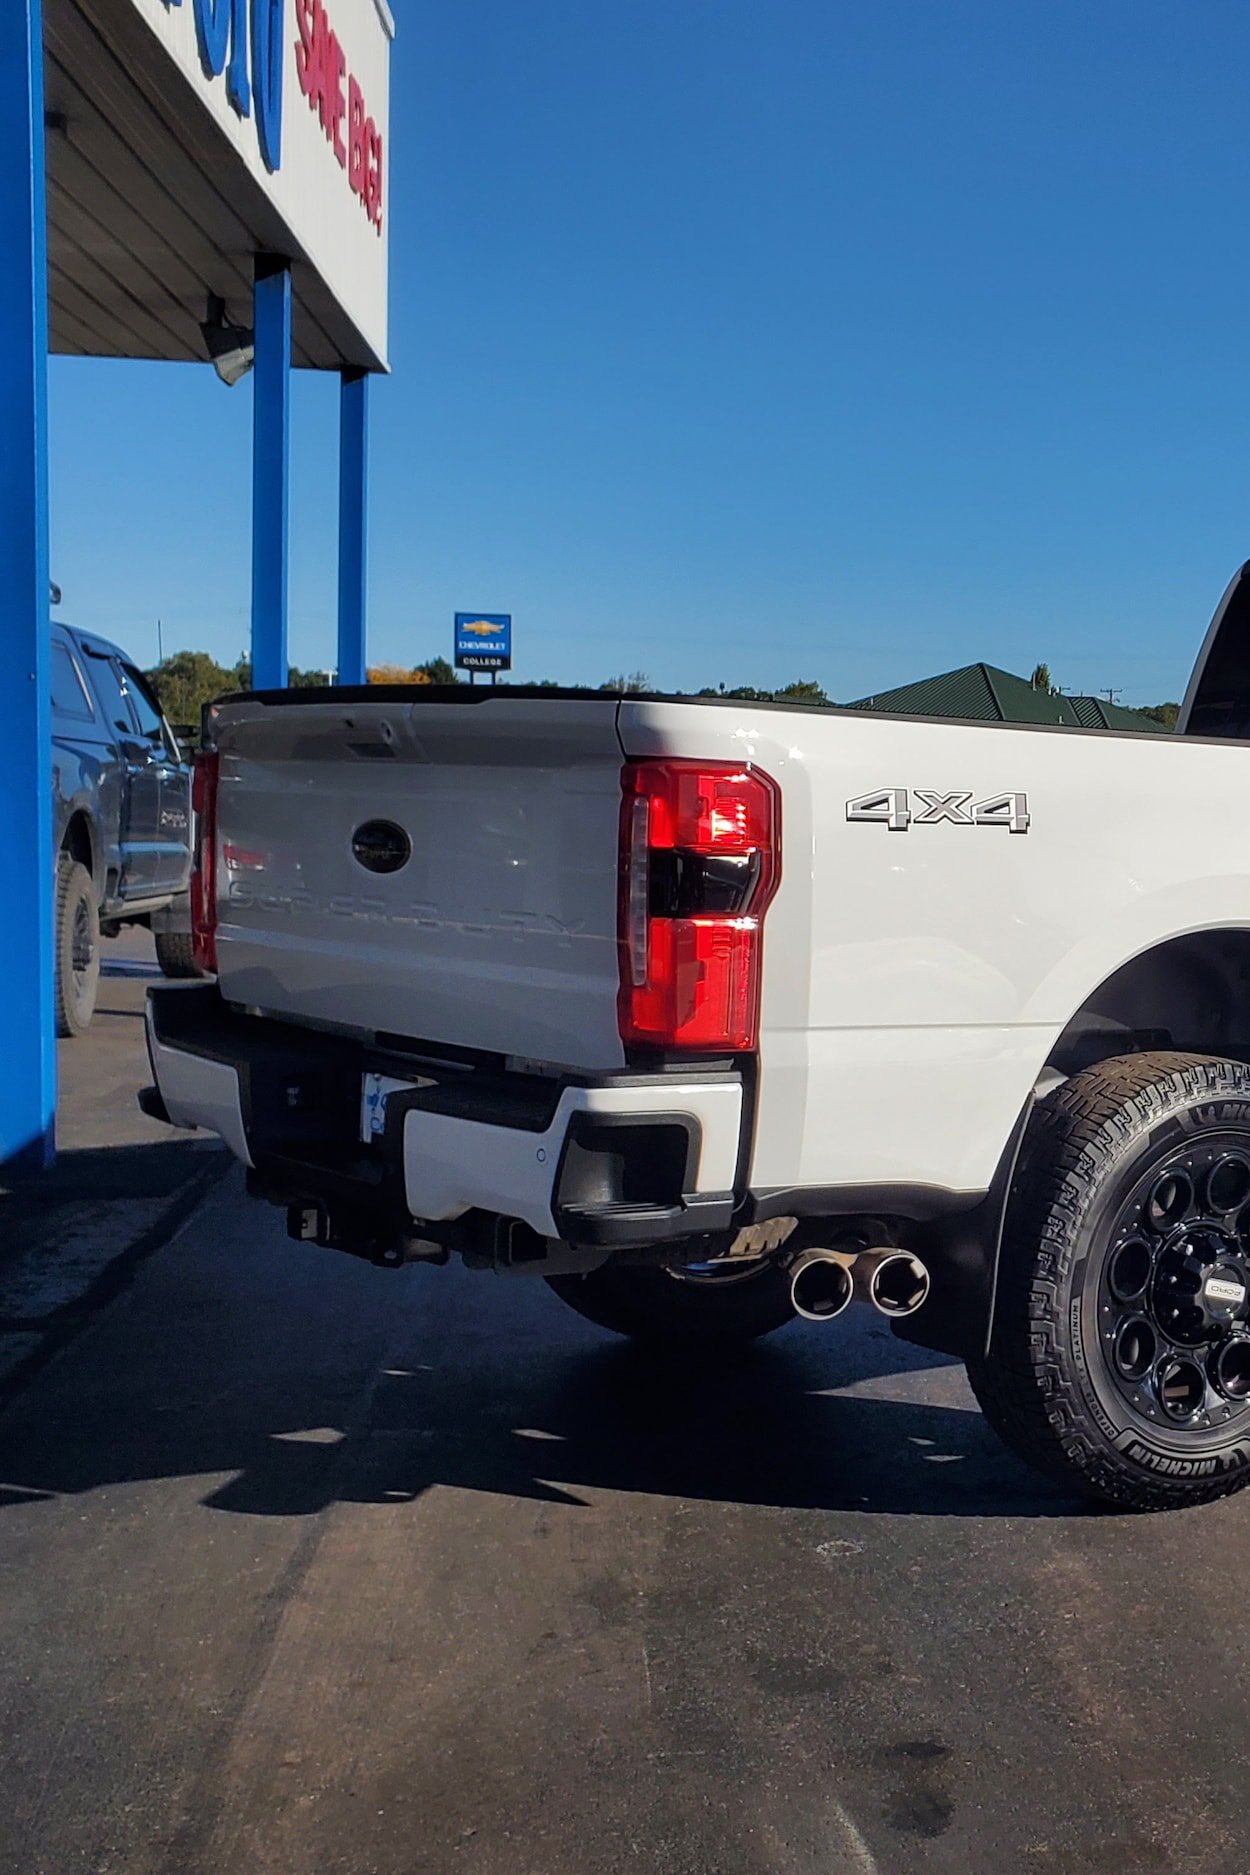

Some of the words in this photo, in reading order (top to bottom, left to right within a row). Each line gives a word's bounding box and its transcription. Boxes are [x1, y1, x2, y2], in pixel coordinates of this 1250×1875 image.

[294, 0, 346, 169] SAVE
[463, 657, 502, 666] COLLEGE
[1210, 1285, 1241, 1297] FORD
[1072, 1304, 1082, 1361] PLATINUM
[1085, 1390, 1116, 1437] DEFENDER
[1128, 1443, 1218, 1476] MICHELIN
